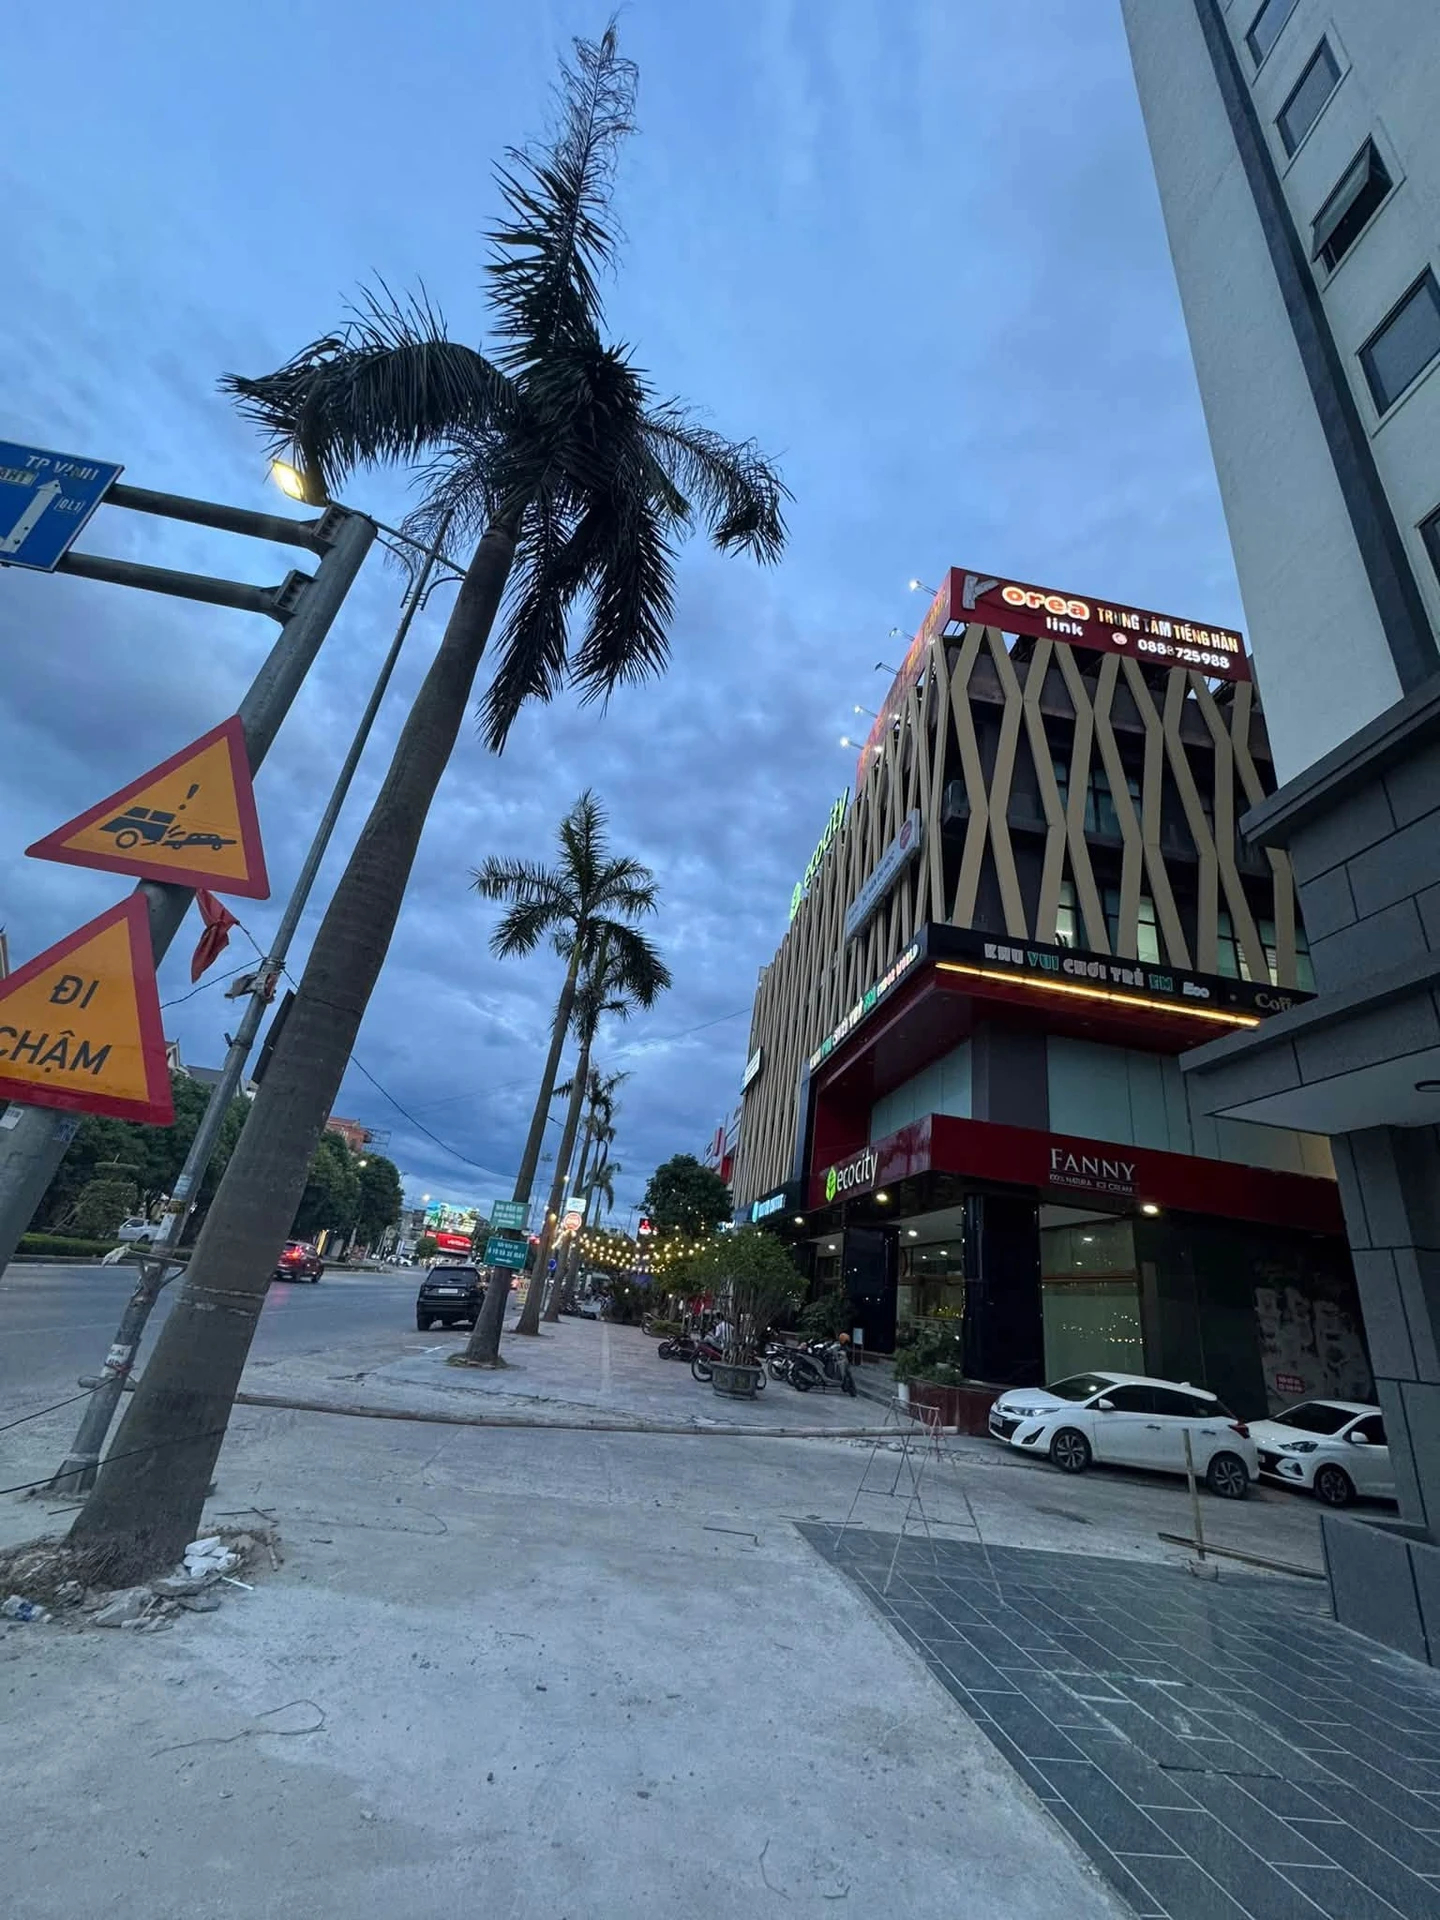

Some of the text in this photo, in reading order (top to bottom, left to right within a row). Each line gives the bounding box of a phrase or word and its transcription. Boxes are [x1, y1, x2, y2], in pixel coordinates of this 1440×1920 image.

[25, 455, 51, 470] TP
[1046, 616, 1084, 637] link
[1097, 607, 1140, 631] TRUNG
[1143, 616, 1172, 638] TÂM
[1173, 622, 1210, 647] TIẾNG
[984, 943, 1174, 992] KHU VUI CHƠI TRẺ EM
[50, 974, 99, 1010] ĐI
[837, 1147, 878, 1191] ecocity
[1051, 1148, 1135, 1181] FANNY
